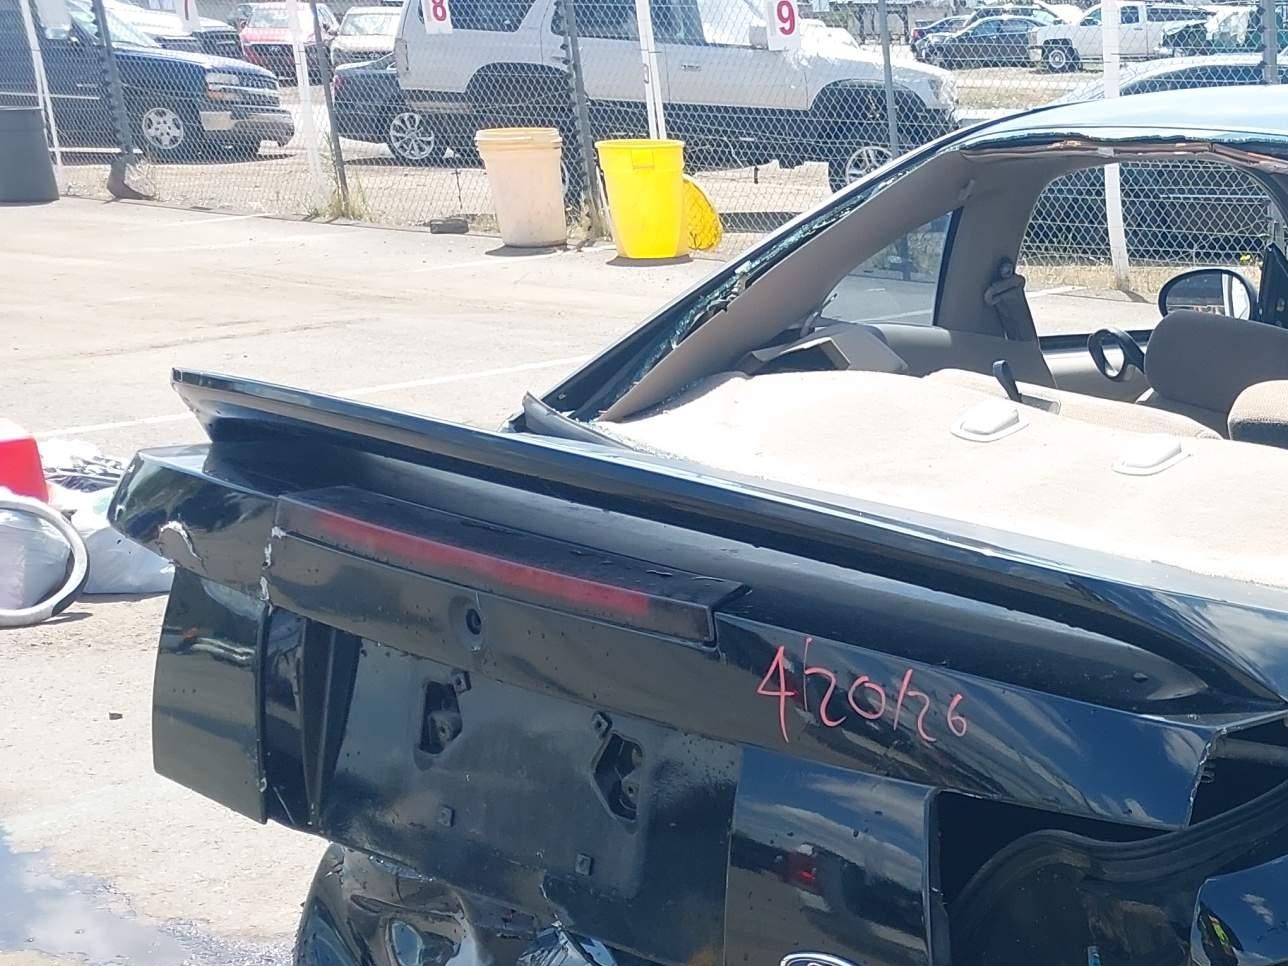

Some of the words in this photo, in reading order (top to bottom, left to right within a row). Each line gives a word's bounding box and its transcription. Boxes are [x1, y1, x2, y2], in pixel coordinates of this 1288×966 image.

[432, 0, 448, 21] 8
[776, 0, 796, 36] 9
[757, 637, 968, 744] 4/20/26
